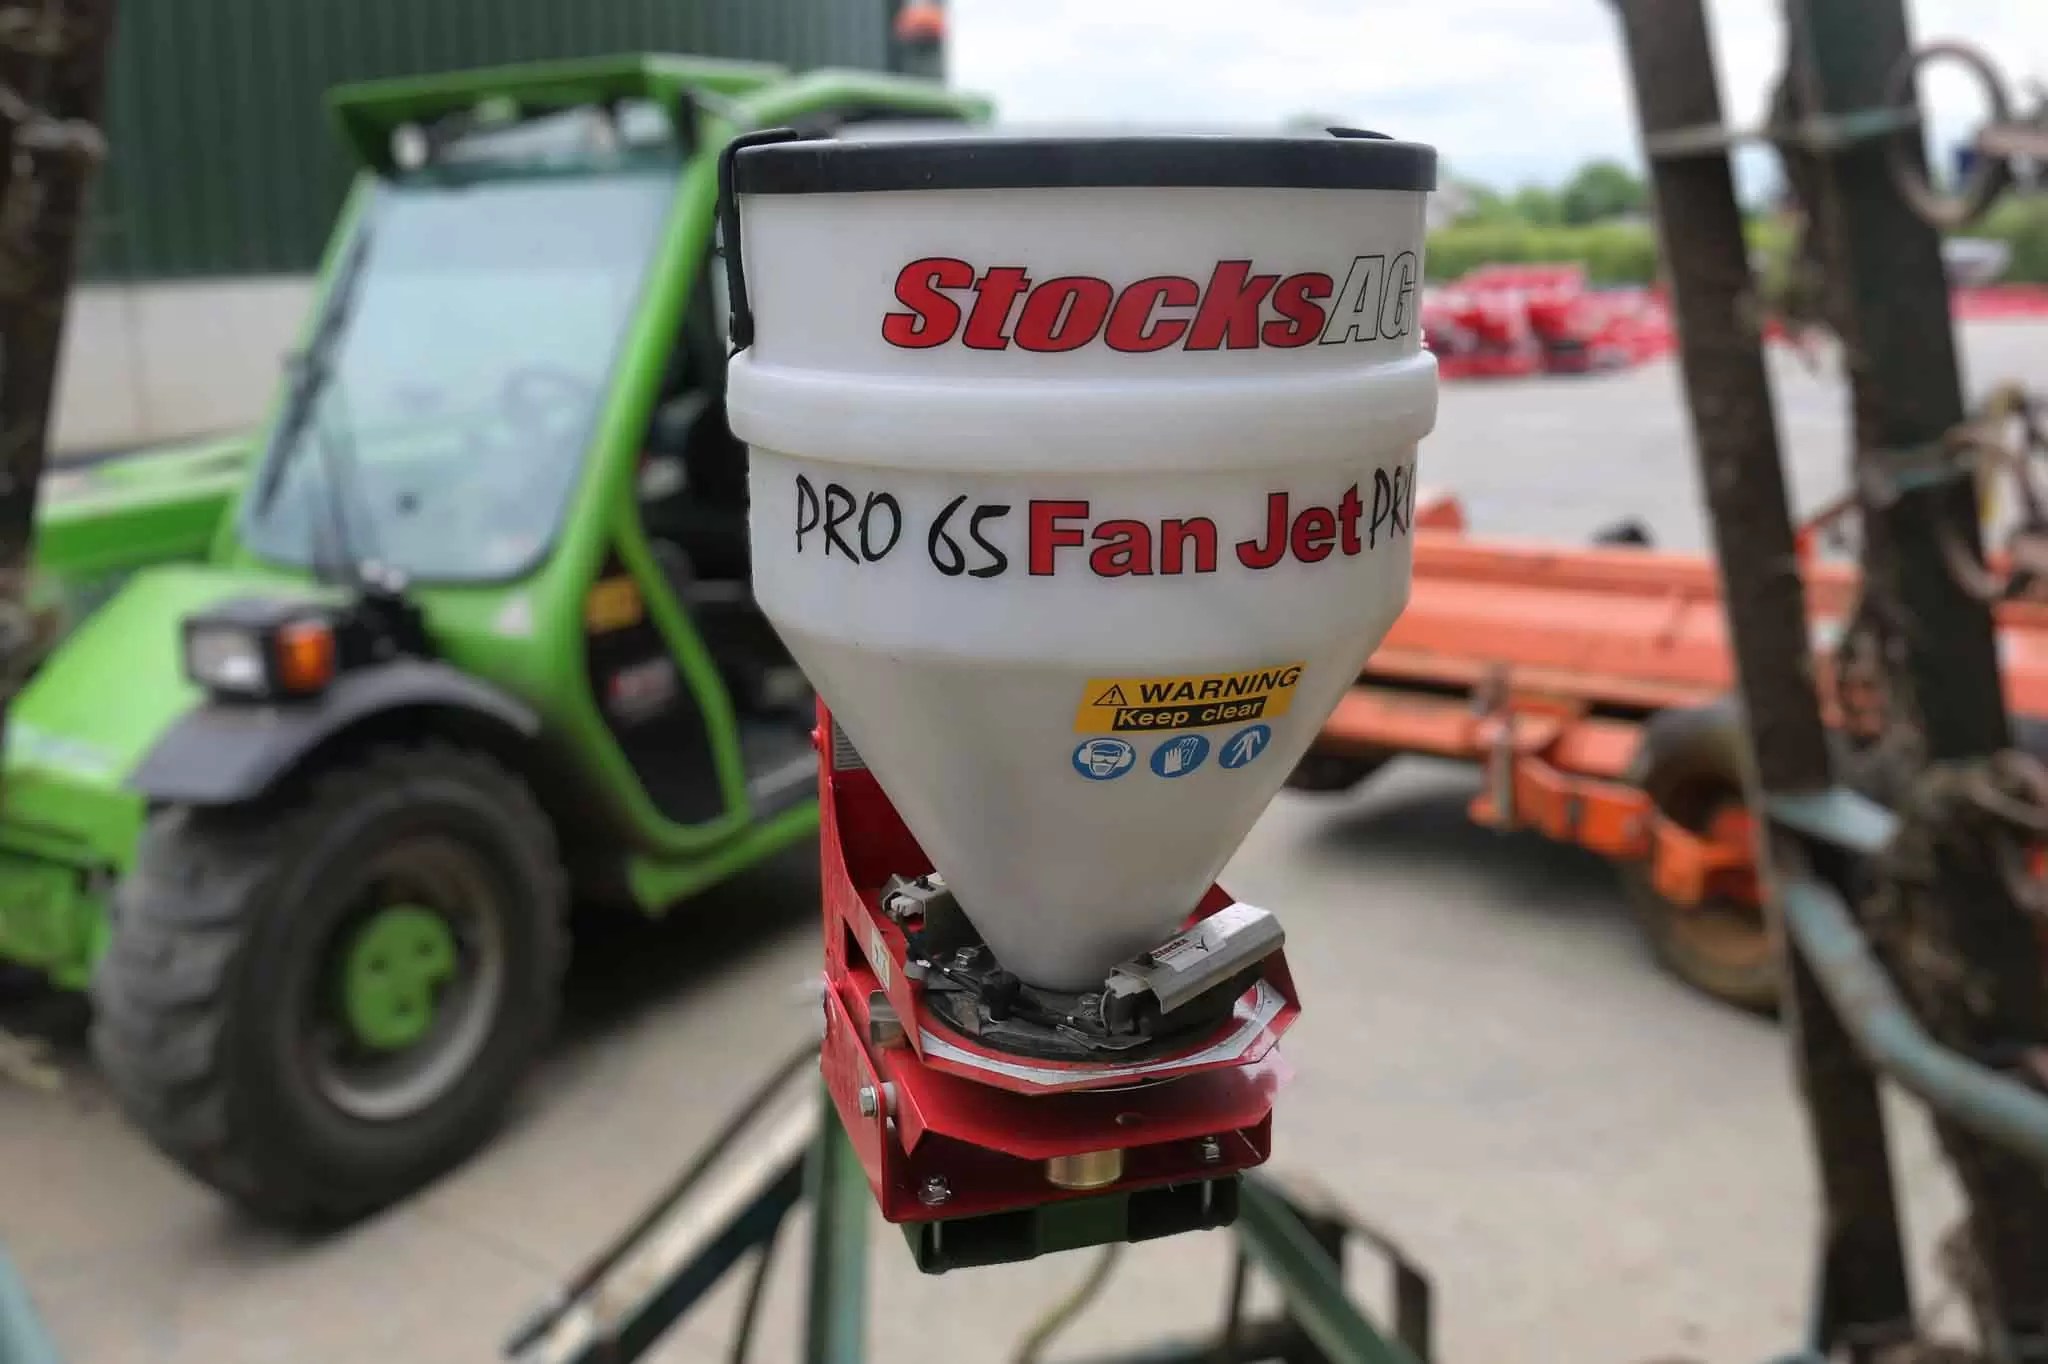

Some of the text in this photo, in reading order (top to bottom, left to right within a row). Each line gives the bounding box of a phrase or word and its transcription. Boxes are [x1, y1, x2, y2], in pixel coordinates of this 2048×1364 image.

[882, 251, 1417, 354] StocksAG
[795, 472, 1012, 579] PRO 65
[1028, 484, 1364, 577] Fan Jet
[1116, 701, 1263, 728] Keep clear
[1139, 666, 1303, 704] WARNING
